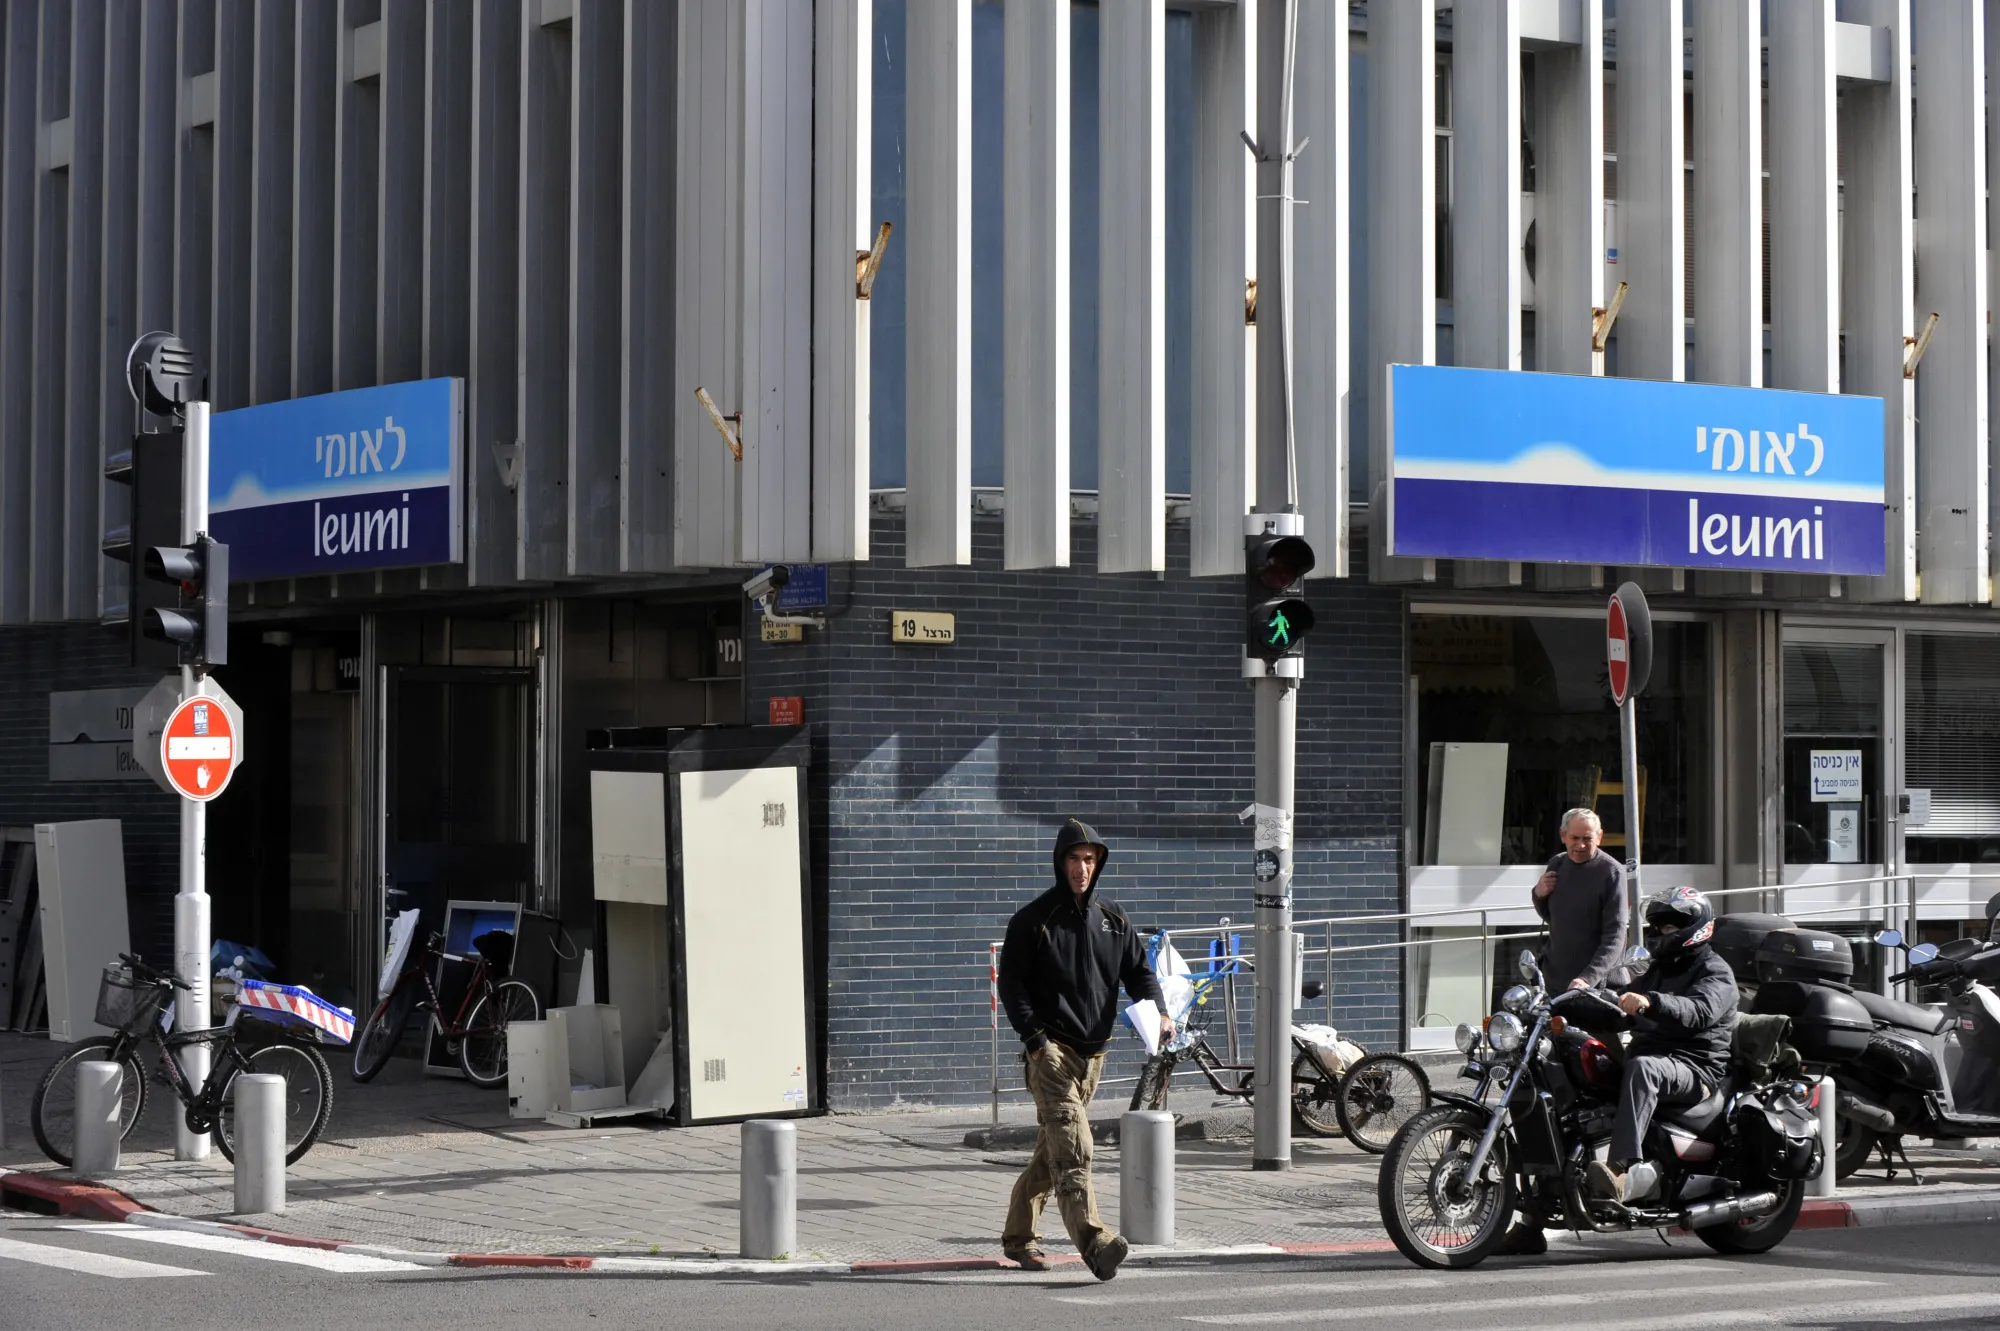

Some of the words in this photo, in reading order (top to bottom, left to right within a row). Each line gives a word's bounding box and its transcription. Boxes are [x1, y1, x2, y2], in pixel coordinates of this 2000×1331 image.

[315, 415, 408, 478] לאומי
[1695, 423, 1825, 477] לאומי
[314, 492, 410, 557] leumi
[1688, 498, 1824, 560] leumi
[766, 629, 788, 640] 24-30
[901, 618, 916, 638] 19
[922, 625, 951, 639] הרצל
[718, 637, 742, 663] ומי
[338, 656, 361, 679] ומי
[116, 707, 134, 730] ומי
[1813, 755, 1843, 769] כניסה
[1845, 755, 1860, 772] אין
[1821, 779, 1839, 788] מסביב
[1839, 779, 1859, 788] הכניסה
